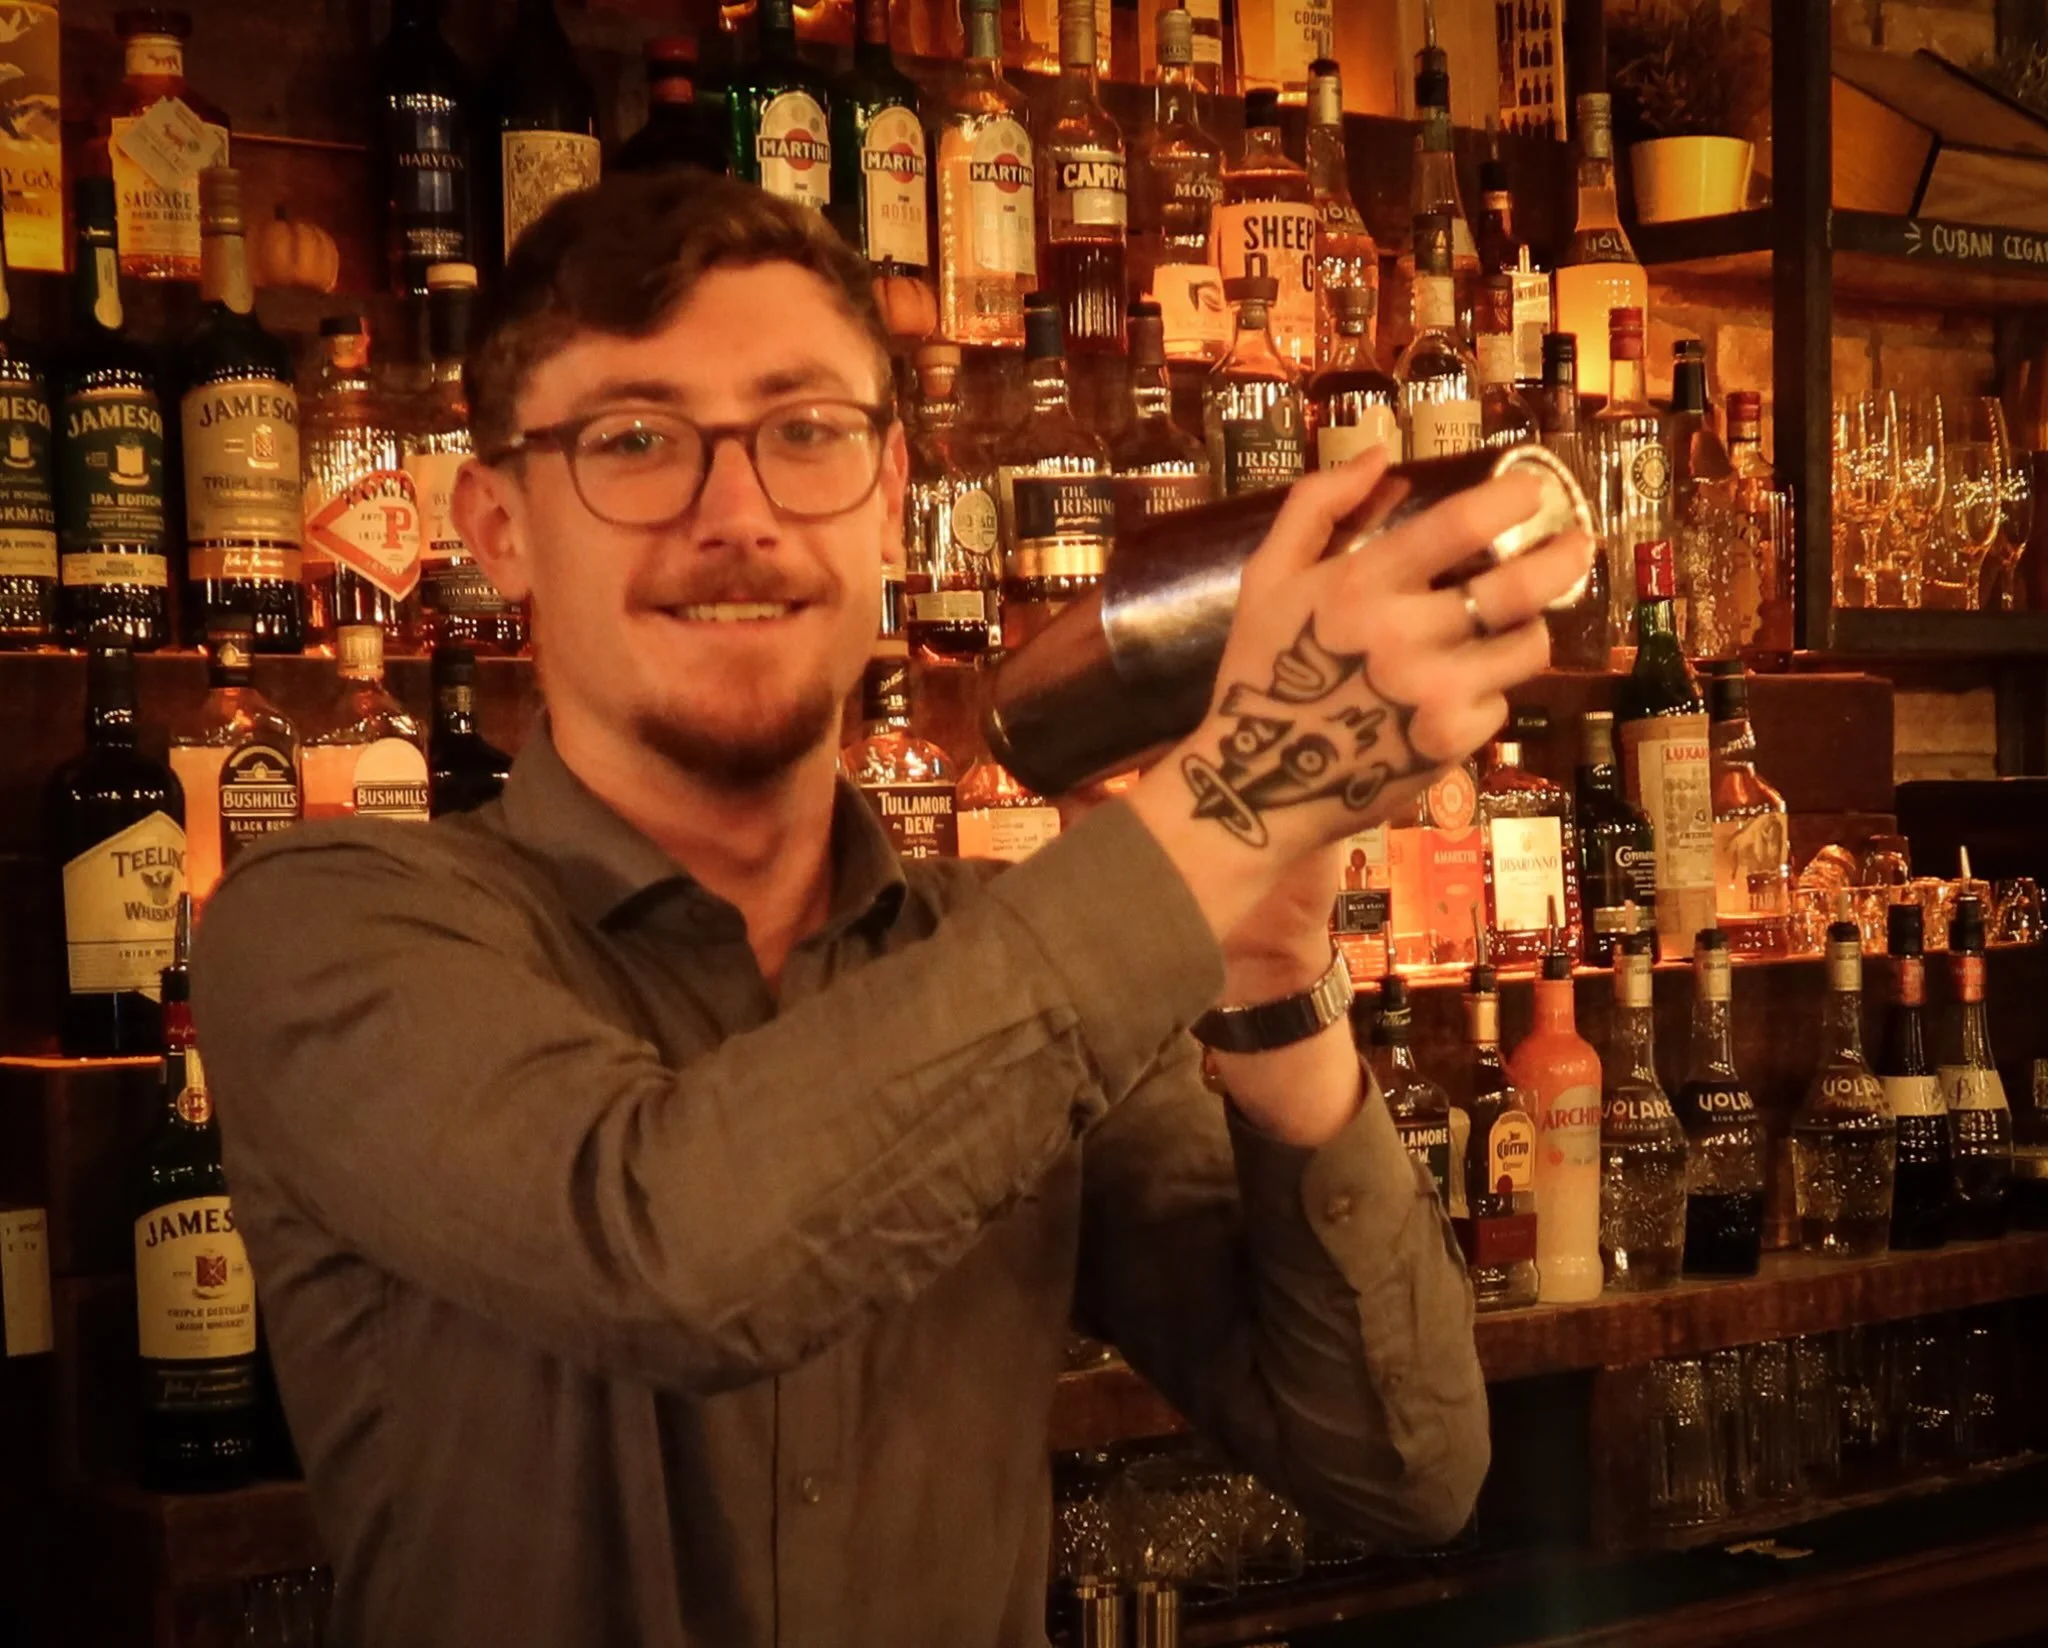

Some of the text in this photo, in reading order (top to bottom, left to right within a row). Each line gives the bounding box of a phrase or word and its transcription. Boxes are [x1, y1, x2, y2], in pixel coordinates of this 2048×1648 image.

[761, 138, 829, 163] MARTINI
[400, 152, 464, 169] HARVEYS
[123, 191, 193, 209] SAUSAGE
[1243, 215, 1314, 250] SHEEP
[1932, 223, 1994, 259] CUBAN
[1061, 485, 1088, 498] THE
[379, 505, 413, 550] P
[223, 791, 298, 809] BUSHMILLS
[357, 789, 428, 806] BUSHMILLS
[877, 791, 953, 816] TULLAMORE
[229, 819, 264, 833] BLACK
[904, 817, 936, 835] DEW
[1499, 856, 1559, 874] DISARONNO
